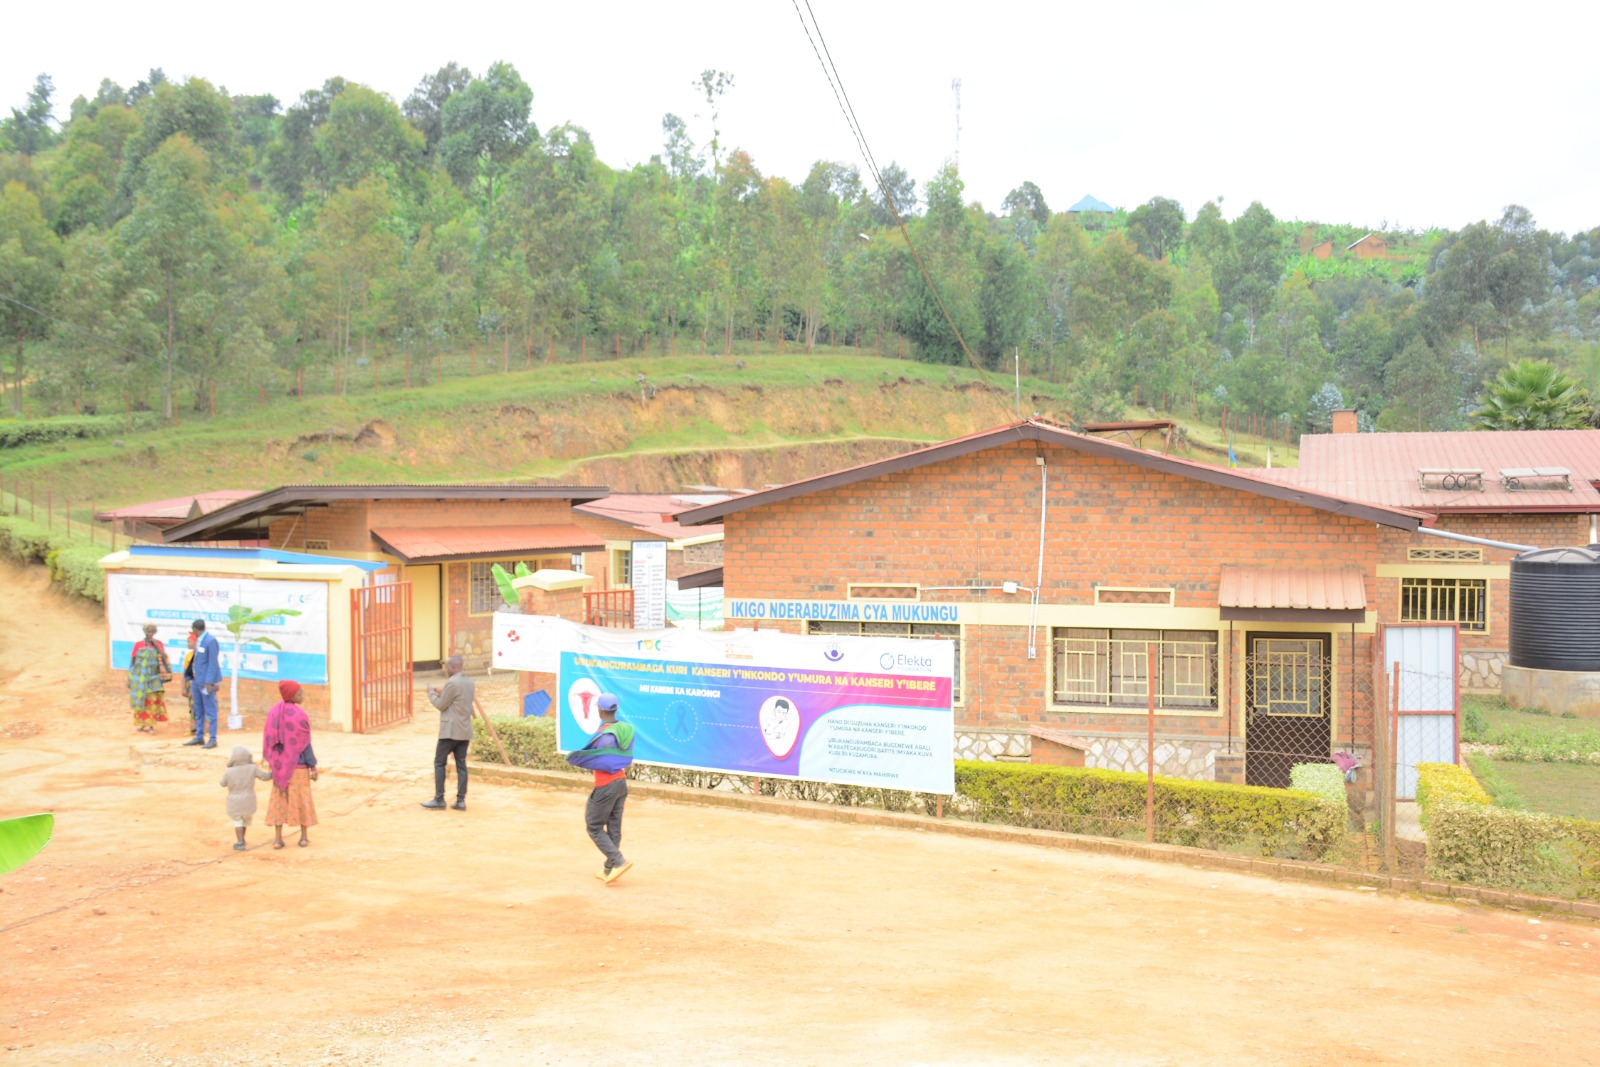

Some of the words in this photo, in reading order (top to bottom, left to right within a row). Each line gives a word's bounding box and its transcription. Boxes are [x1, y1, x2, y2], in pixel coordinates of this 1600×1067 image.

[191, 589, 214, 598] USAID
[731, 601, 766, 618] IKIGO
[770, 602, 860, 620] NDERABUZIMA
[863, 604, 888, 621] CYA
[892, 605, 958, 622] MUKUNGU
[897, 654, 932, 667] Elekta
[574, 657, 664, 673] UBUKANGURAMBAGA
[666, 665, 688, 675] KURI
[692, 666, 730, 678] KANSERI
[733, 670, 786, 682] Y'INKONDO
[788, 673, 832, 685] Y'UMURA
[834, 676, 848, 686] NA
[850, 677, 894, 688] KANSERI
[896, 680, 936, 691] Y'IBERE
[674, 687, 685, 696] KA
[686, 688, 720, 698] KARONGI
